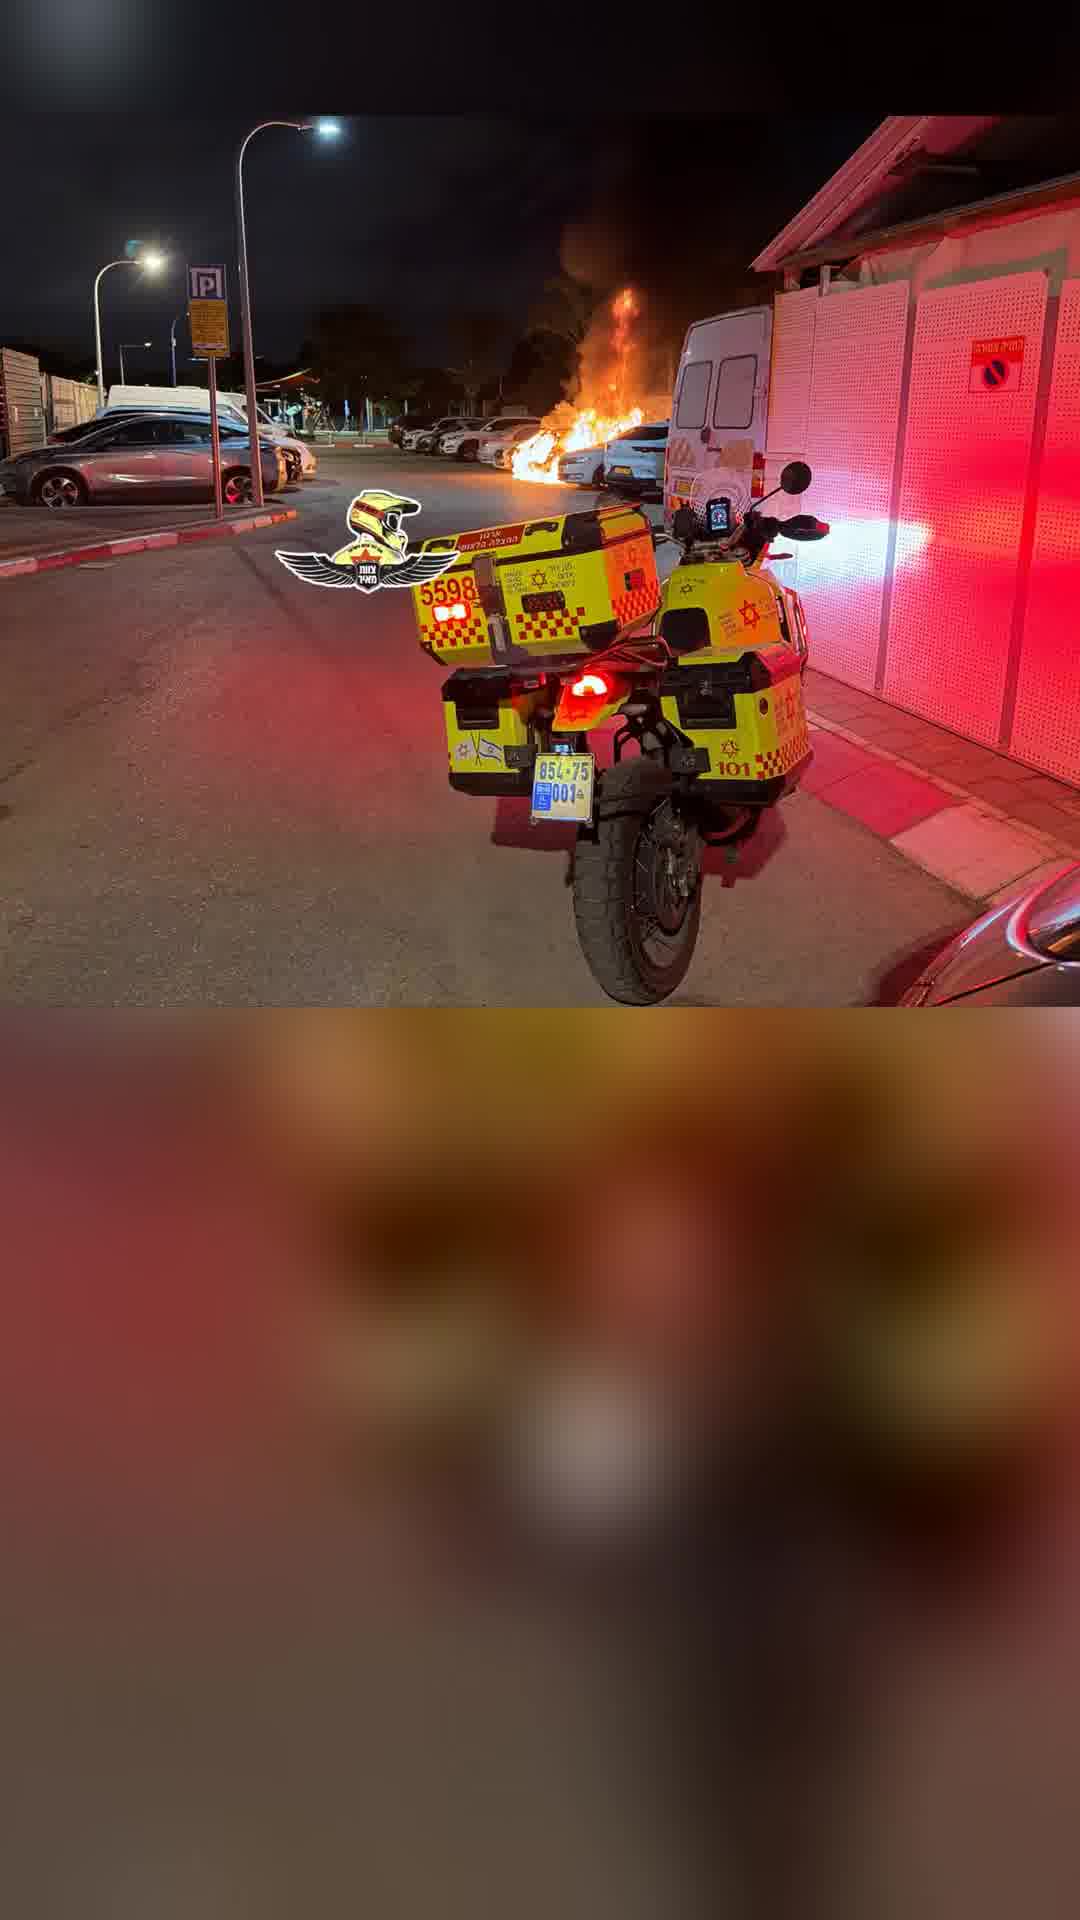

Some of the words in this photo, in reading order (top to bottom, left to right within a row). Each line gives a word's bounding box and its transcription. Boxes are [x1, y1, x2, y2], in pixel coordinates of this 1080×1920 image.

[420, 576, 477, 606] 5598
[717, 760, 751, 776] 101
[552, 782, 576, 804] 001
